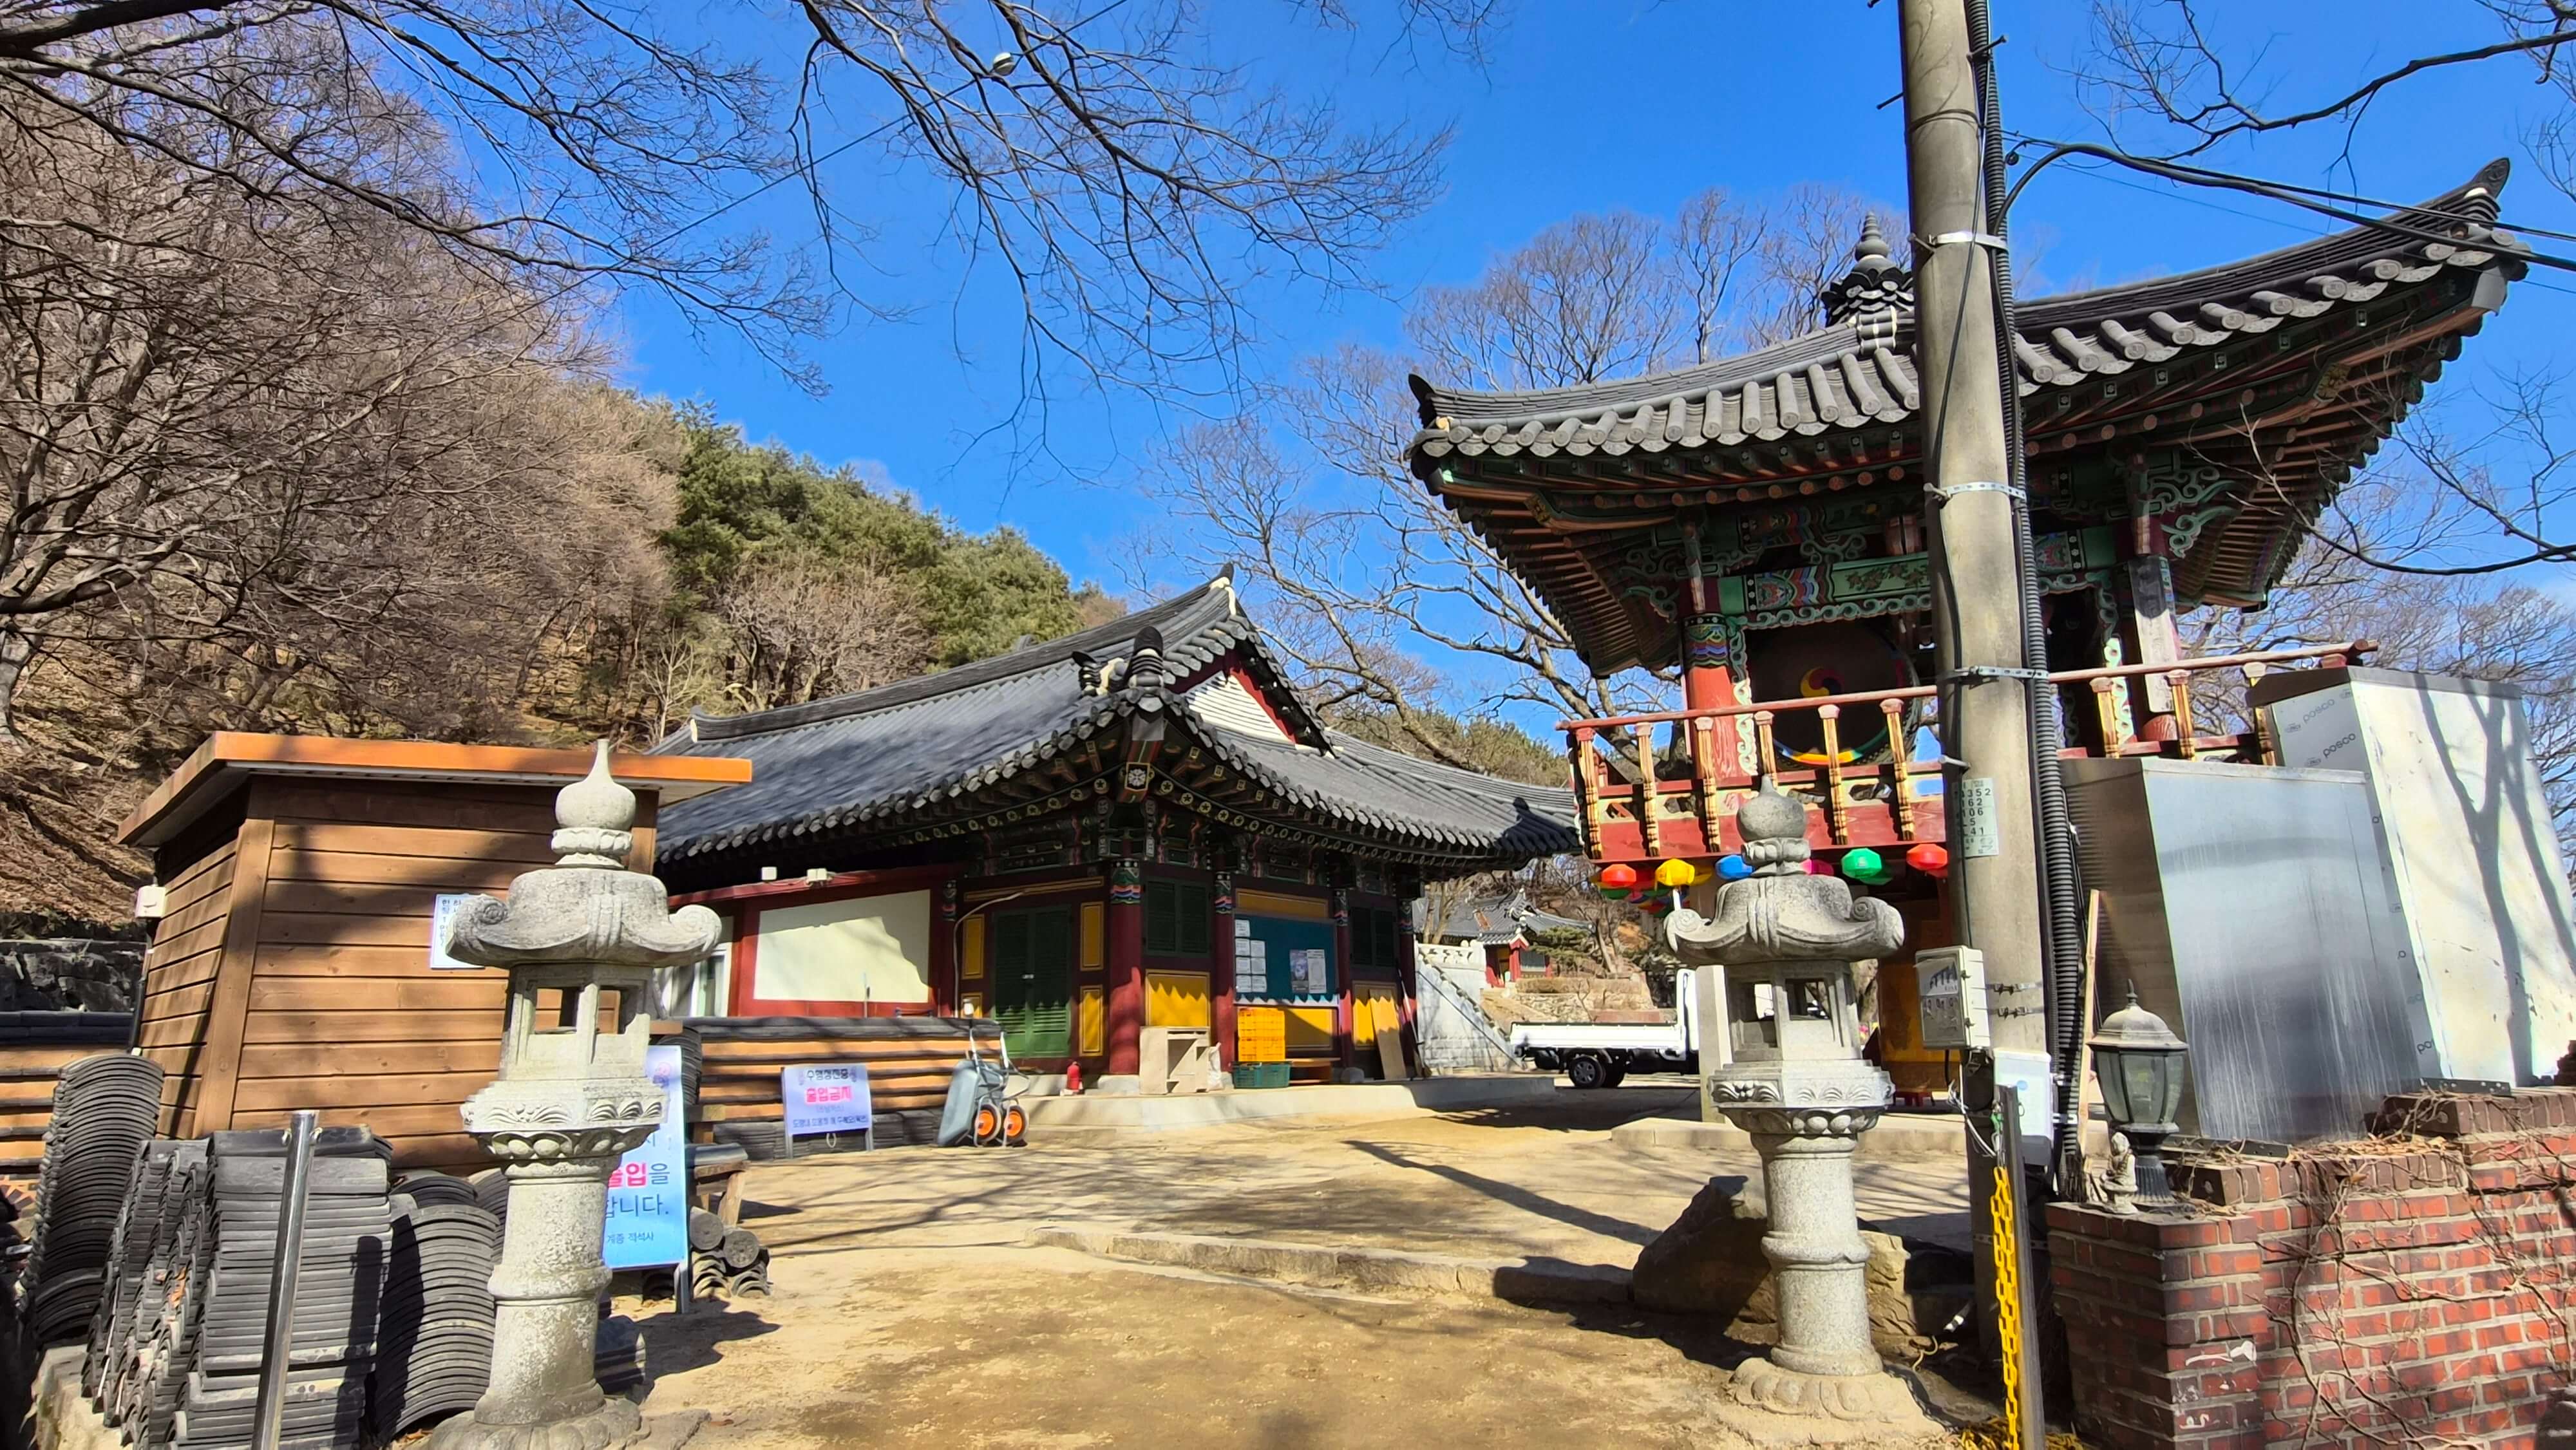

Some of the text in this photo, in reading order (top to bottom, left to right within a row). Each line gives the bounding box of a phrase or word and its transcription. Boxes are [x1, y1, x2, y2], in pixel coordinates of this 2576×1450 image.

[2303, 699, 2334, 724] posco
[2323, 733, 2356, 758] posco
[806, 1086, 852, 1103] 출입금지
